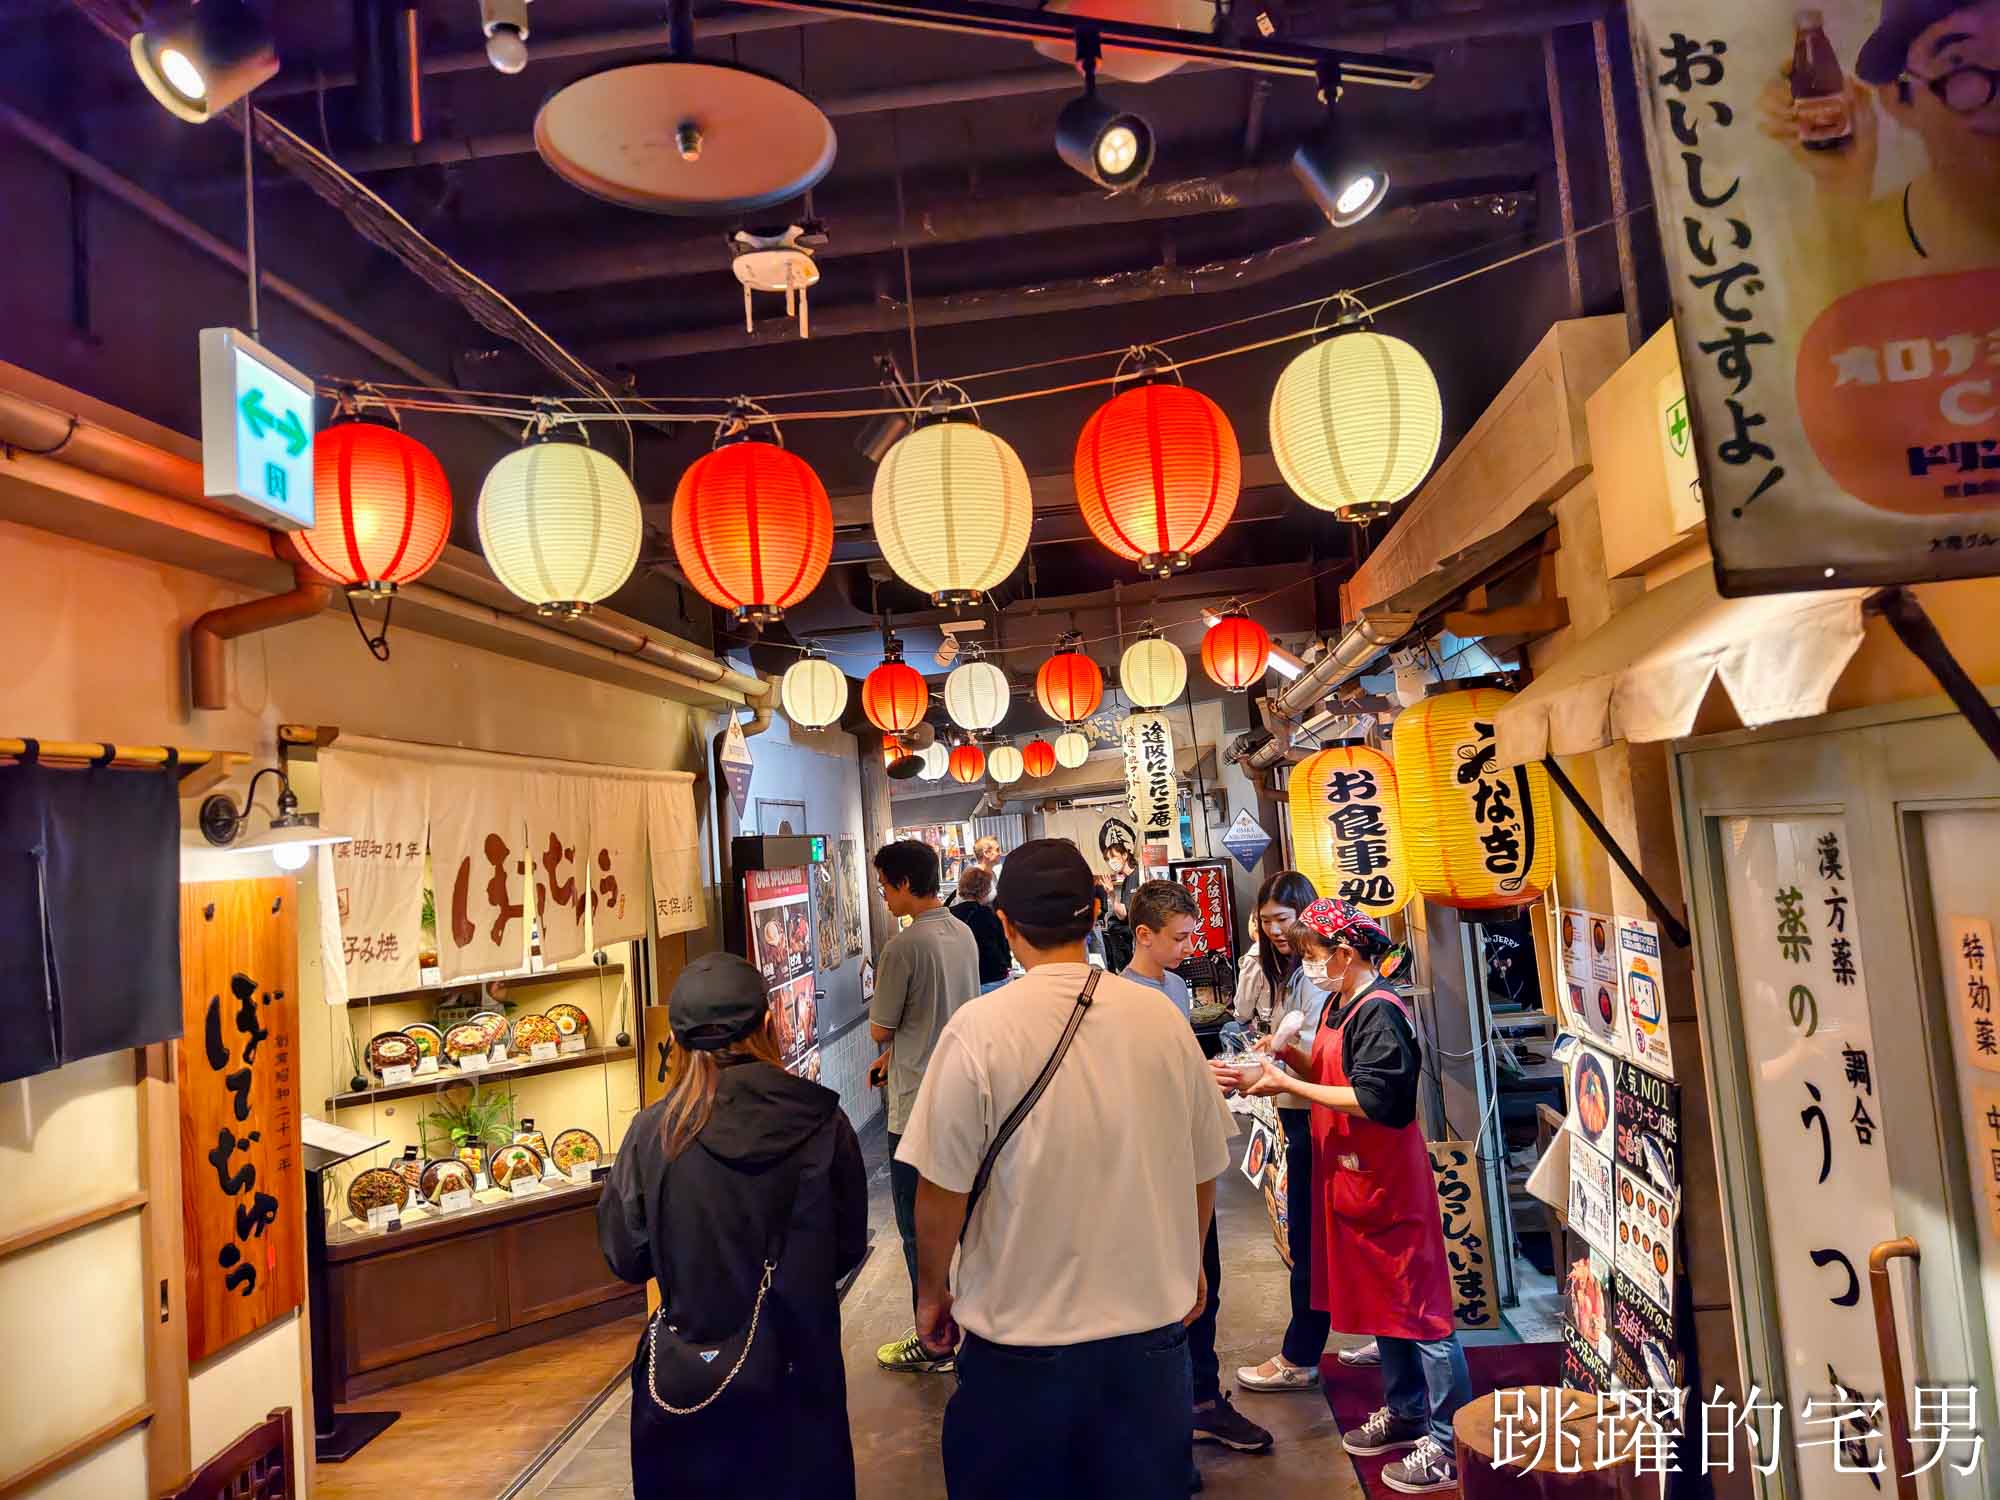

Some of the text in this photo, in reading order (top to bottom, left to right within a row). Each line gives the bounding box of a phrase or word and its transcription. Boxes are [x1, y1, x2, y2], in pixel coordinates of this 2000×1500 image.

[1142, 720, 1171, 827] 逢阪にこにこ庵
[331, 840, 422, 860] 業昭和21年
[1206, 870, 1225, 928] 大阪名物
[1326, 769, 1395, 908] お食事処
[1492, 934, 1520, 949] JERRY
[1817, 832, 1877, 1146] 漢方薬 調合
[1963, 933, 1999, 1055] 特効薬
[204, 972, 284, 1297] ぼてぢゅう
[273, 1034, 292, 1173] 創業昭和二十一年
[1615, 1060, 1639, 1097] 人気
[1429, 1151, 1491, 1326] いらっしゃいませ
